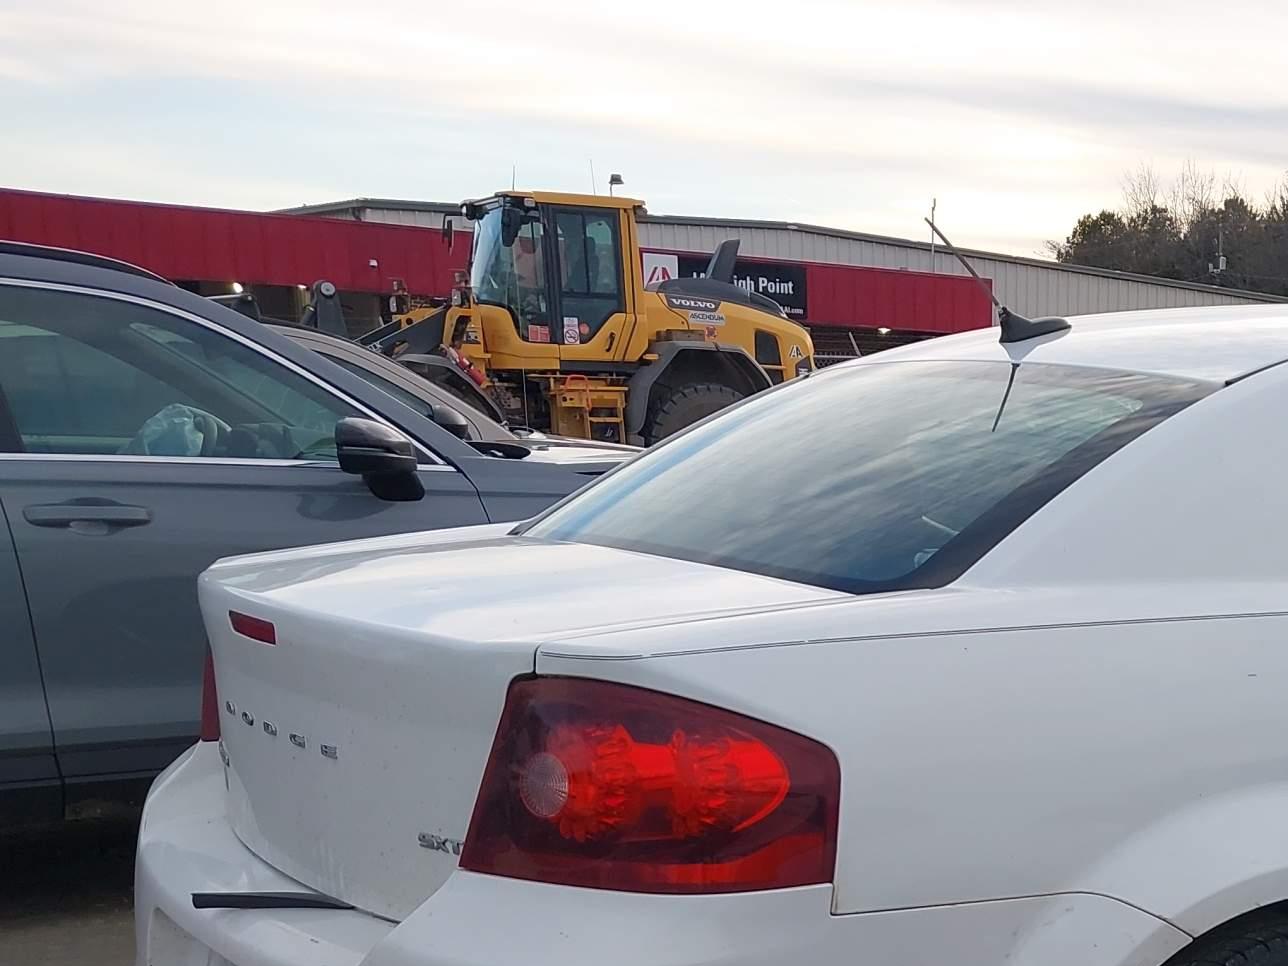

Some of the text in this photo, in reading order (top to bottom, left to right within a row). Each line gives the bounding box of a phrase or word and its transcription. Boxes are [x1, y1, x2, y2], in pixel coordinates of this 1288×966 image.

[759, 276, 794, 295] Point
[671, 298, 716, 309] VOLVO
[225, 700, 339, 761] DODGE
[417, 831, 464, 856] SXT
